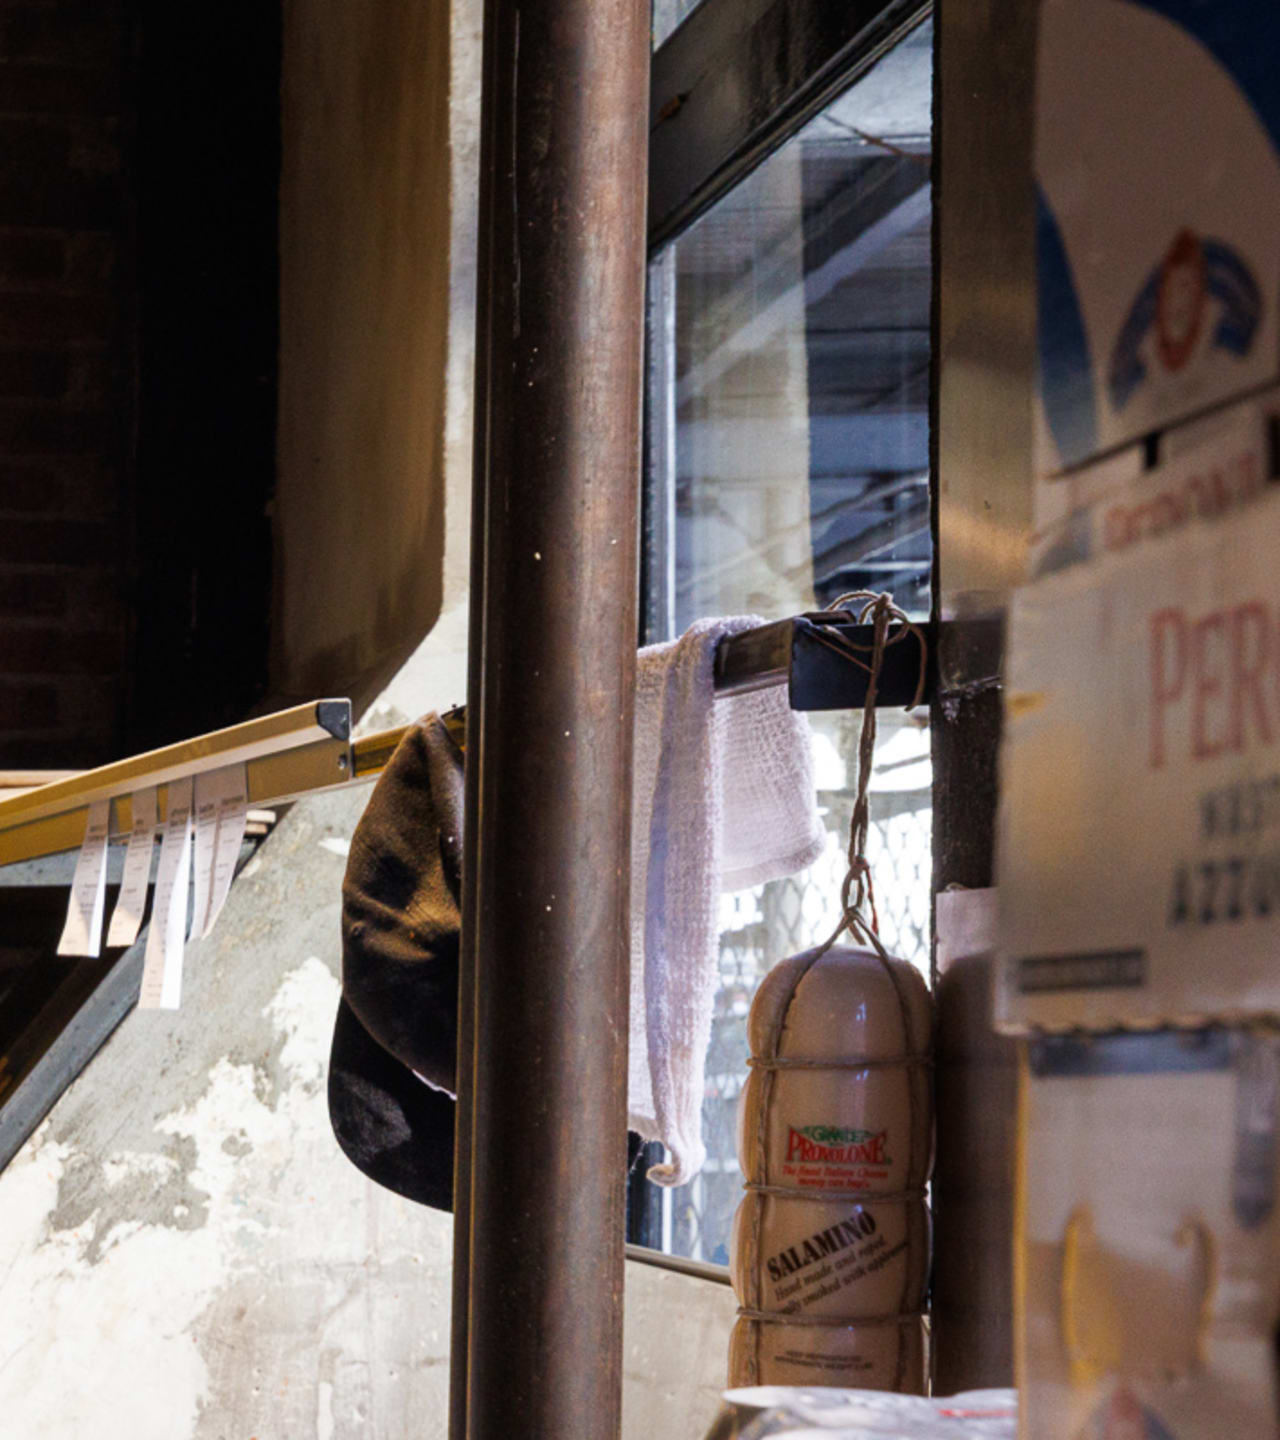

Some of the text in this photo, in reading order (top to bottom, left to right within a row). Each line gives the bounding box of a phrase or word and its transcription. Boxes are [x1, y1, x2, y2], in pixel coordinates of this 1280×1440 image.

[1148, 599, 1280, 770] PER
[785, 1126, 888, 1165] PROVOLONE
[767, 1211, 876, 1282] SALAMINO
[804, 1263, 832, 1285] made
[834, 1250, 856, 1270] and
[803, 1277, 841, 1306] smoked
